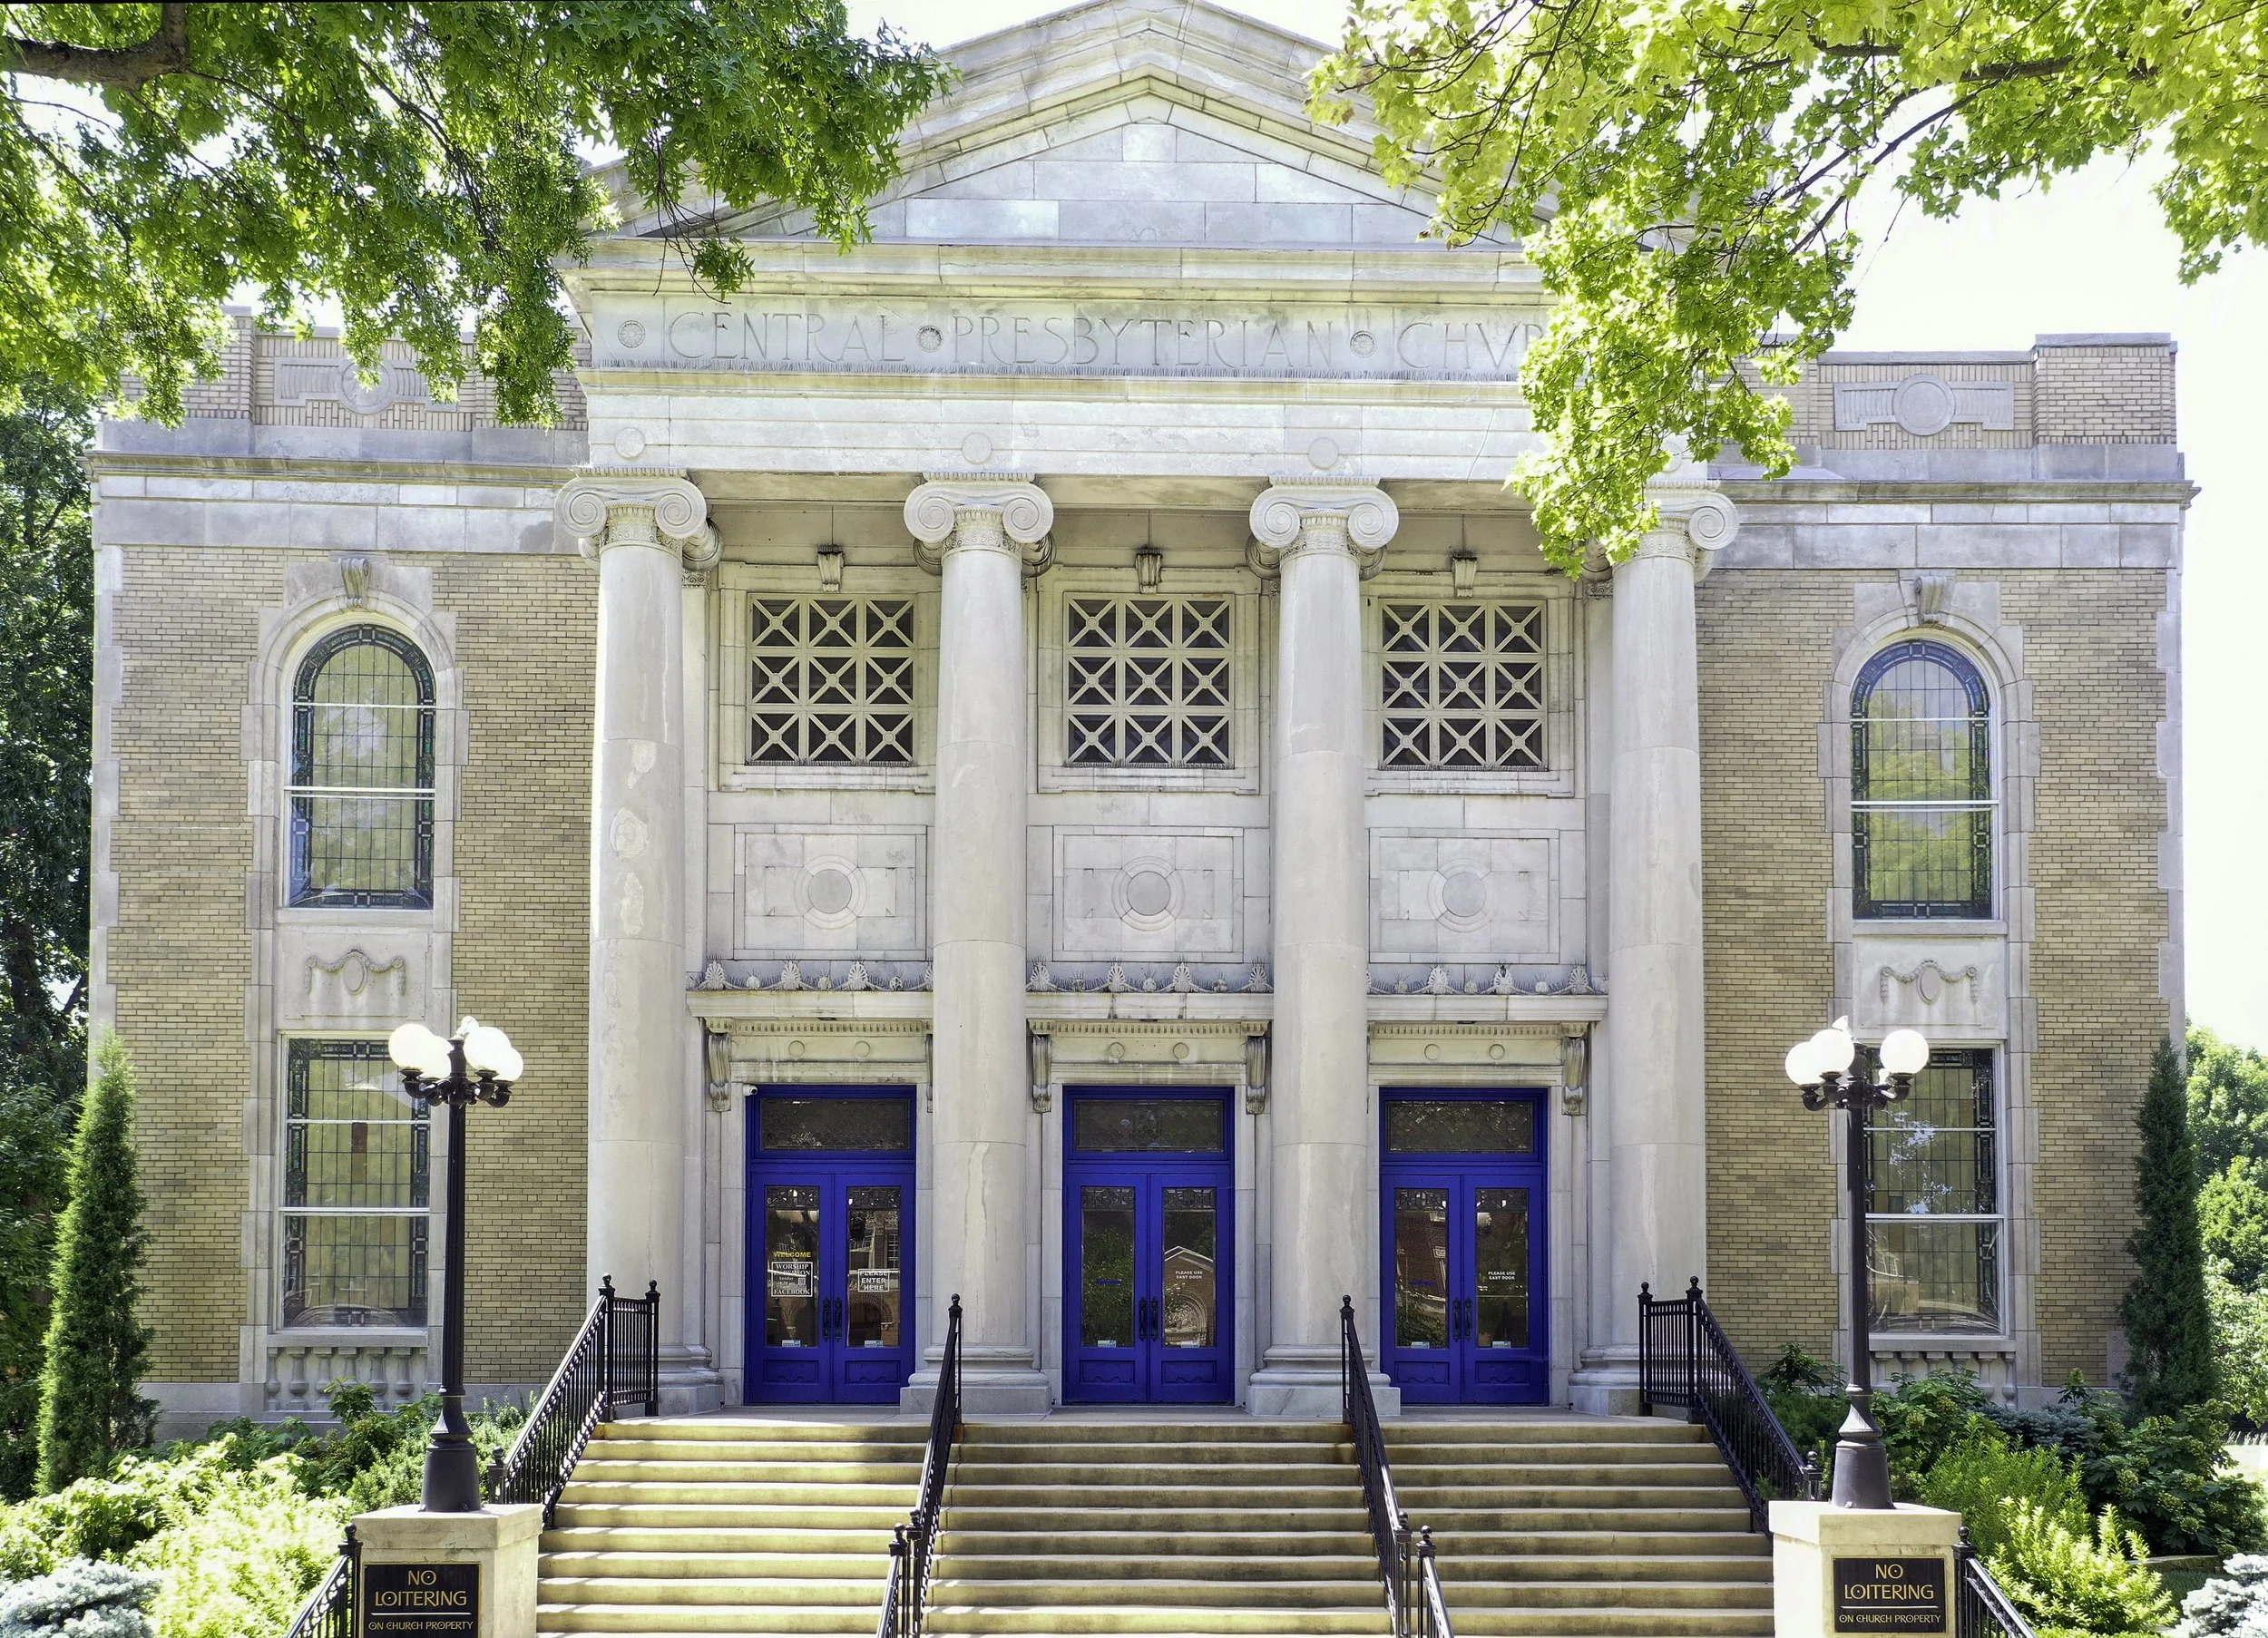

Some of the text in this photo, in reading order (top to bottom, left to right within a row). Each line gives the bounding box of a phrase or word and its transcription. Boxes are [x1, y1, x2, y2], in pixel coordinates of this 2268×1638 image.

[669, 311, 905, 362] CENTRAL
[953, 315, 1333, 367] PRESBYTERIAN
[408, 1570, 436, 1585] NO
[1875, 1564, 1903, 1579] NO
[375, 1591, 467, 1607] LOITERING
[1844, 1584, 1934, 1600] LOITERING
[368, 1621, 474, 1631] ON CHURCH PROPERTY
[1839, 1614, 1941, 1623] ON CHURCH PROPERTY
